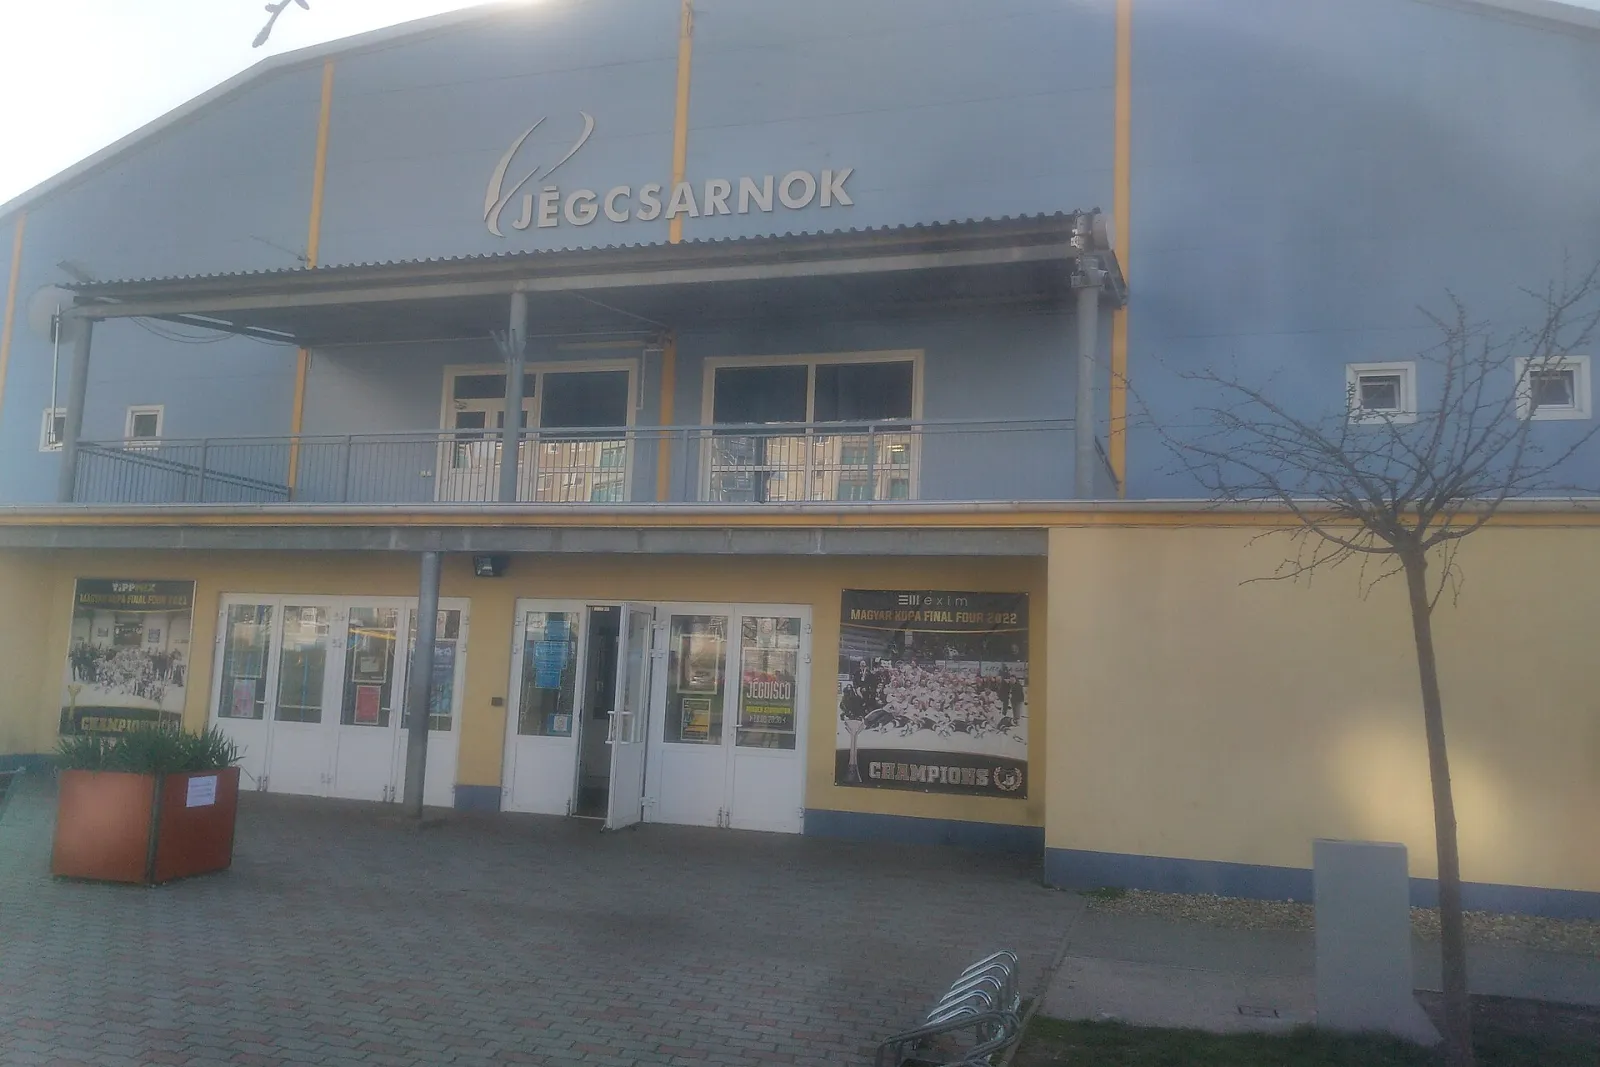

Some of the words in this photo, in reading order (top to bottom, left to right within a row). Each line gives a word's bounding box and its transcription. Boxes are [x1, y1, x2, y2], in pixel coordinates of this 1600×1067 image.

[851, 608, 892, 621] MAGYAR
[894, 610, 921, 622] KUPA
[923, 610, 954, 623] FINAL
[956, 611, 984, 624] FOUR
[986, 612, 1017, 625] 2022
[869, 761, 989, 787] CHAMPIONS
